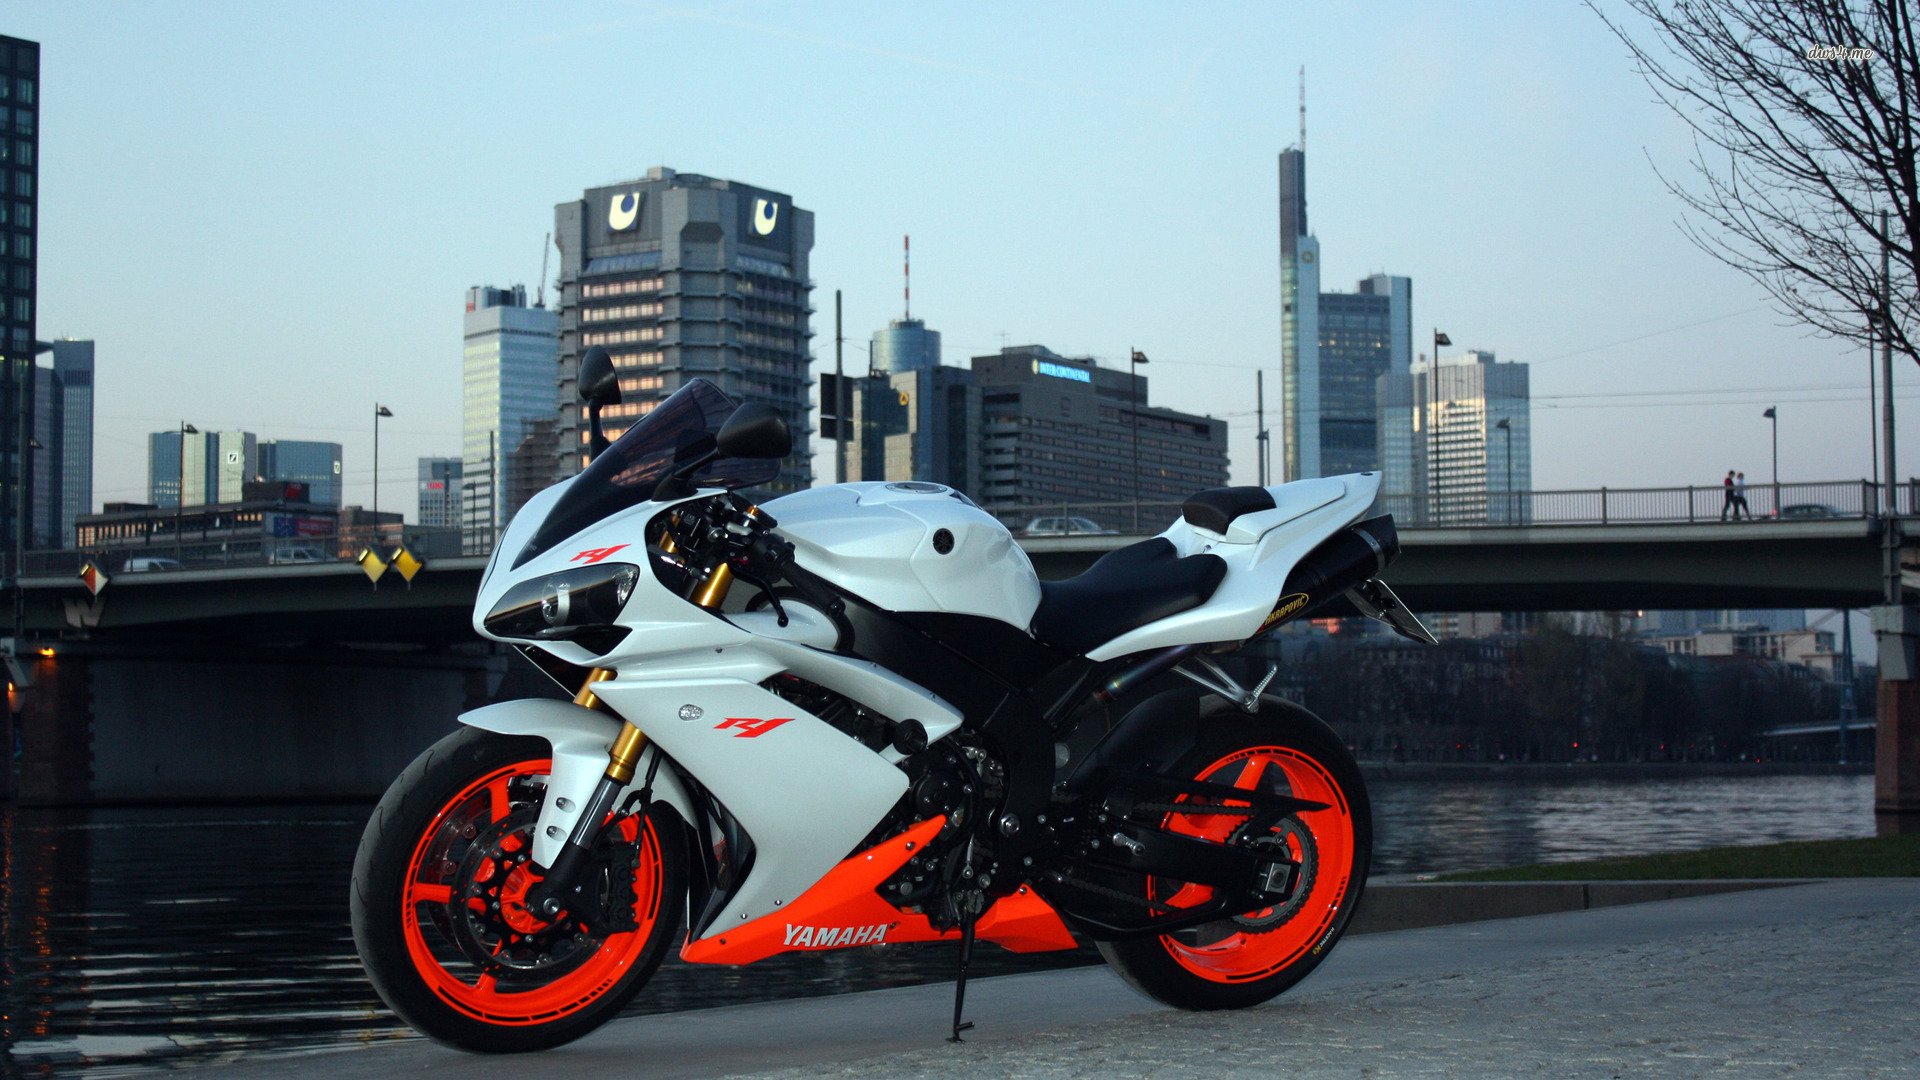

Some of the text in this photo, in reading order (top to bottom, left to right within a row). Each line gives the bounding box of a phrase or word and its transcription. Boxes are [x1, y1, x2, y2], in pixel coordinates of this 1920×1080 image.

[569, 543, 632, 565] R1
[713, 717, 796, 738] R1
[783, 923, 888, 947] YAMAHA
